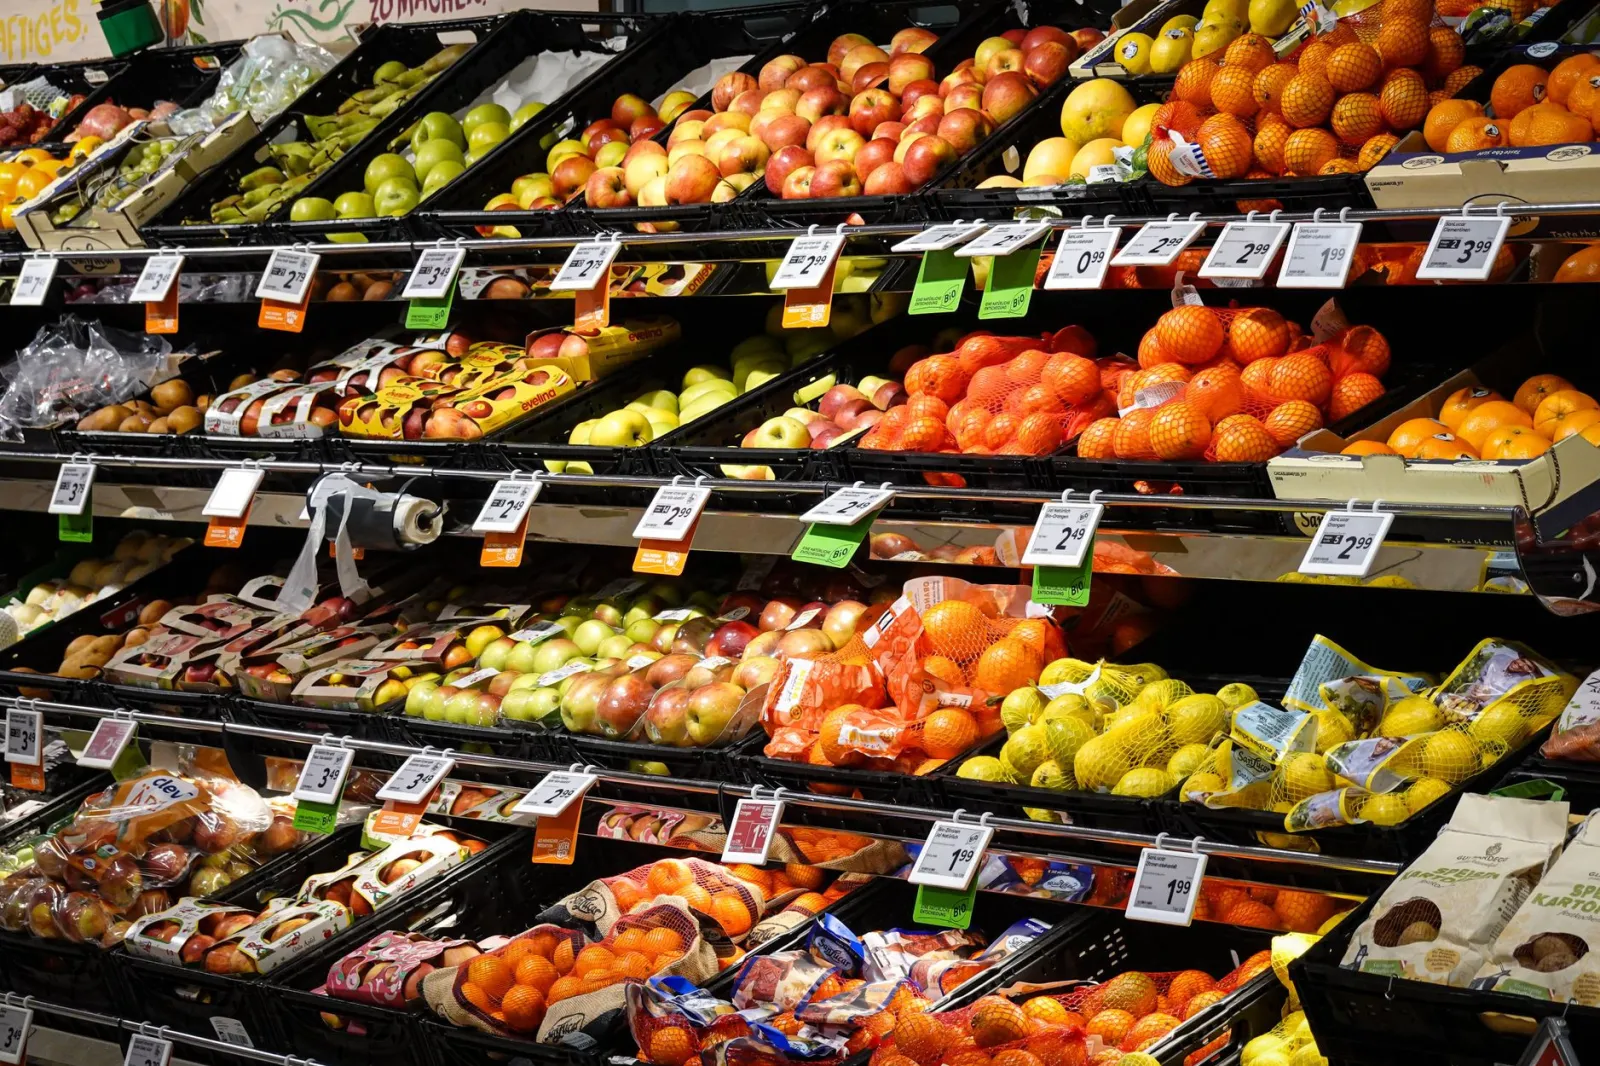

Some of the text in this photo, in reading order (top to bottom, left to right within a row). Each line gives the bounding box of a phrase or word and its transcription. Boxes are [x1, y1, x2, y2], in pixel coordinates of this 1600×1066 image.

[944, 290, 956, 304] BiO
[1012, 293, 1025, 309] BiO
[434, 308, 445, 322] BiO
[521, 387, 557, 413] evelina
[833, 547, 848, 559] BiO
[1071, 581, 1084, 596] BiO
[953, 904, 967, 919] BiO
[817, 937, 852, 969] SanLucar
